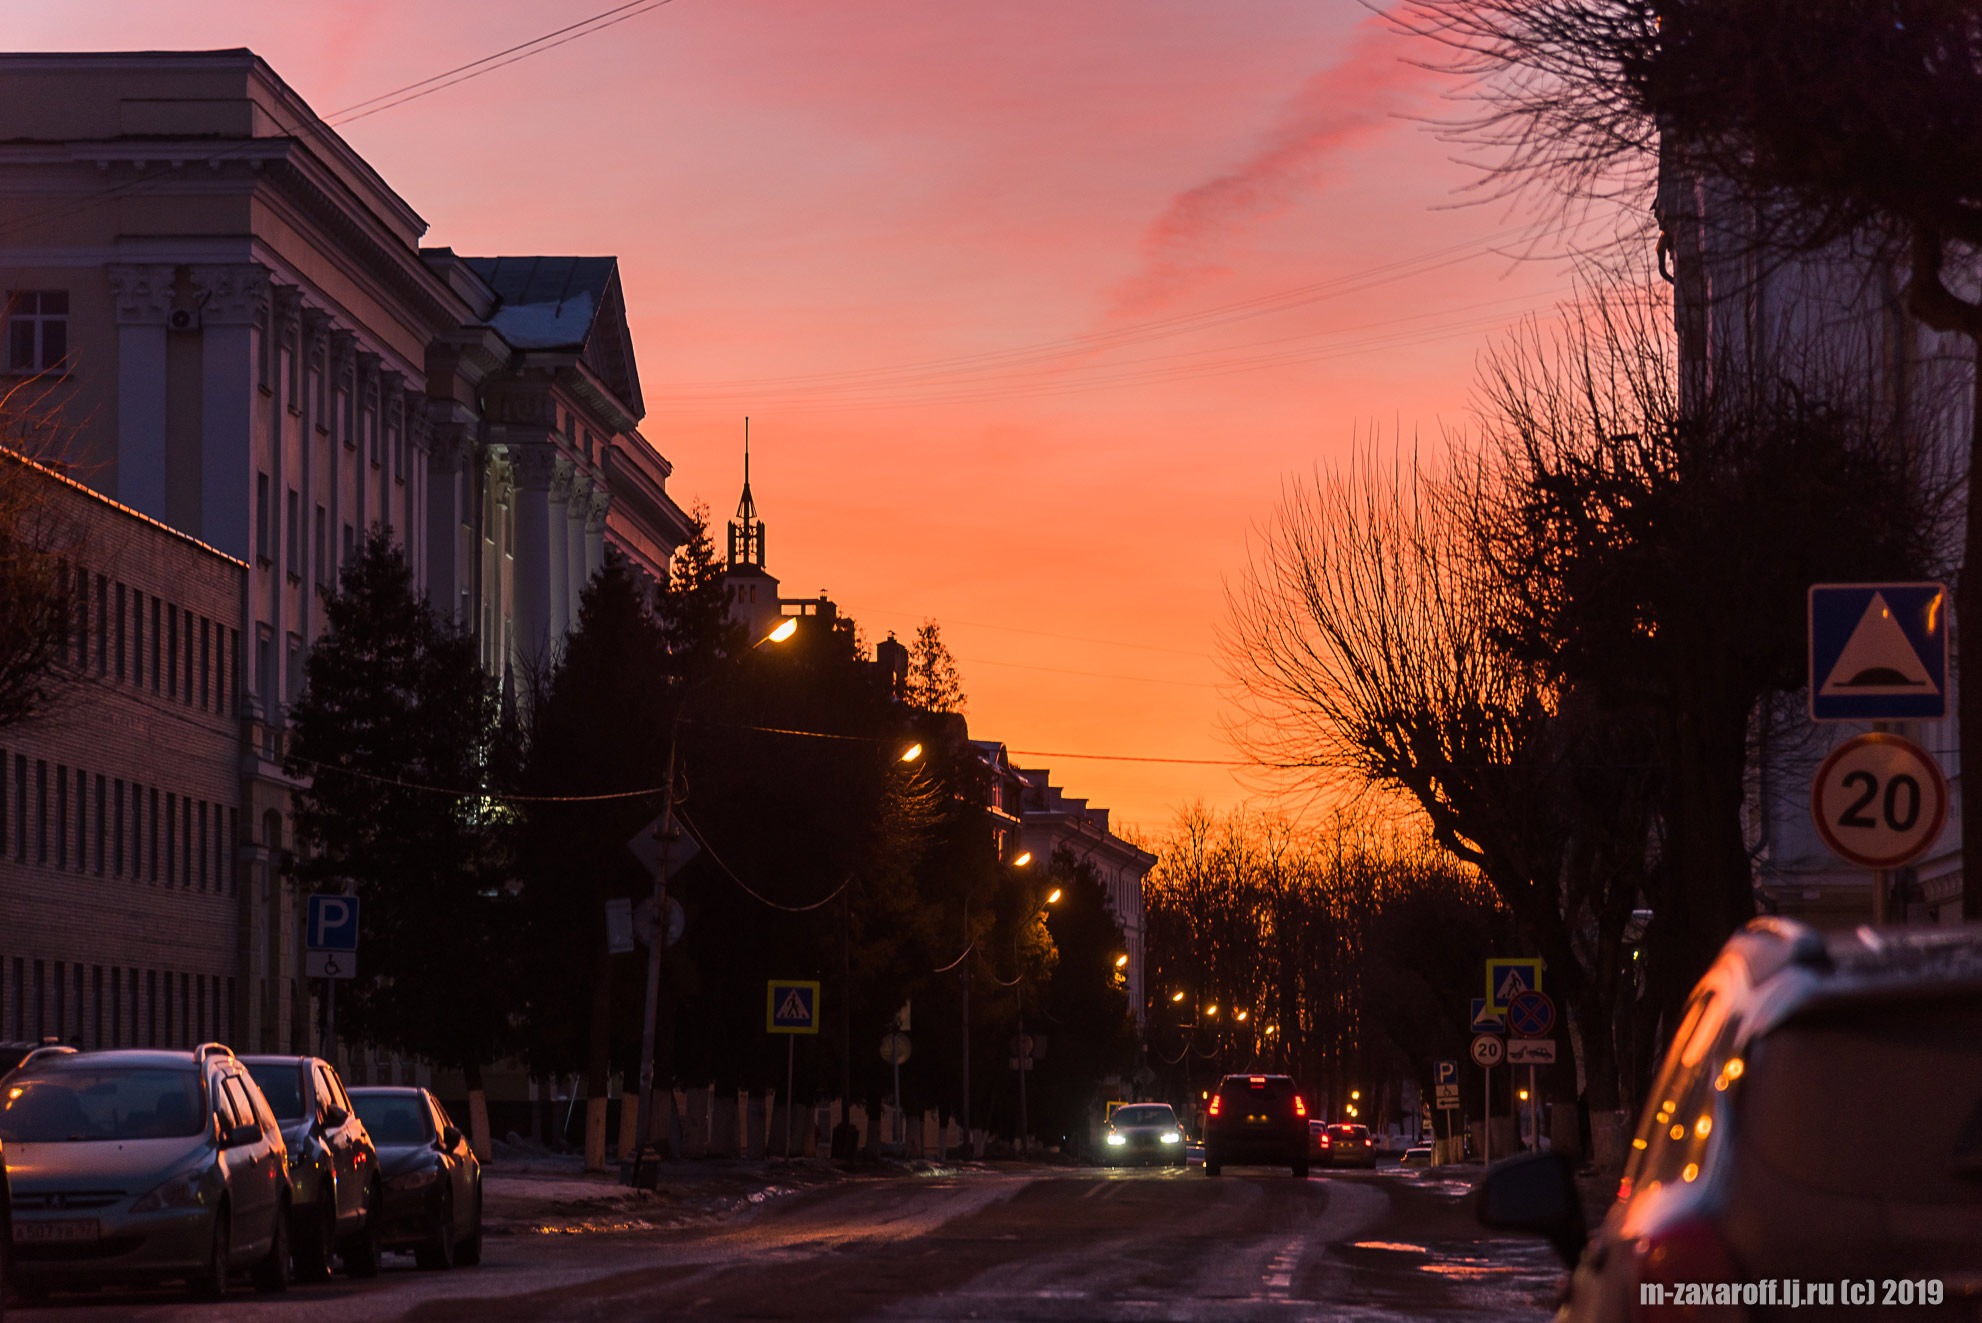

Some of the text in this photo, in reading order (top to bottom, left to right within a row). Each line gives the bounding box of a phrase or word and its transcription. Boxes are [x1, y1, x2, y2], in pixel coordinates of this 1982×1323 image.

[1837, 770, 1921, 832] 20
[317, 898, 350, 945] P
[1478, 1043, 1498, 1057] 20
[1440, 1063, 1454, 1084] P
